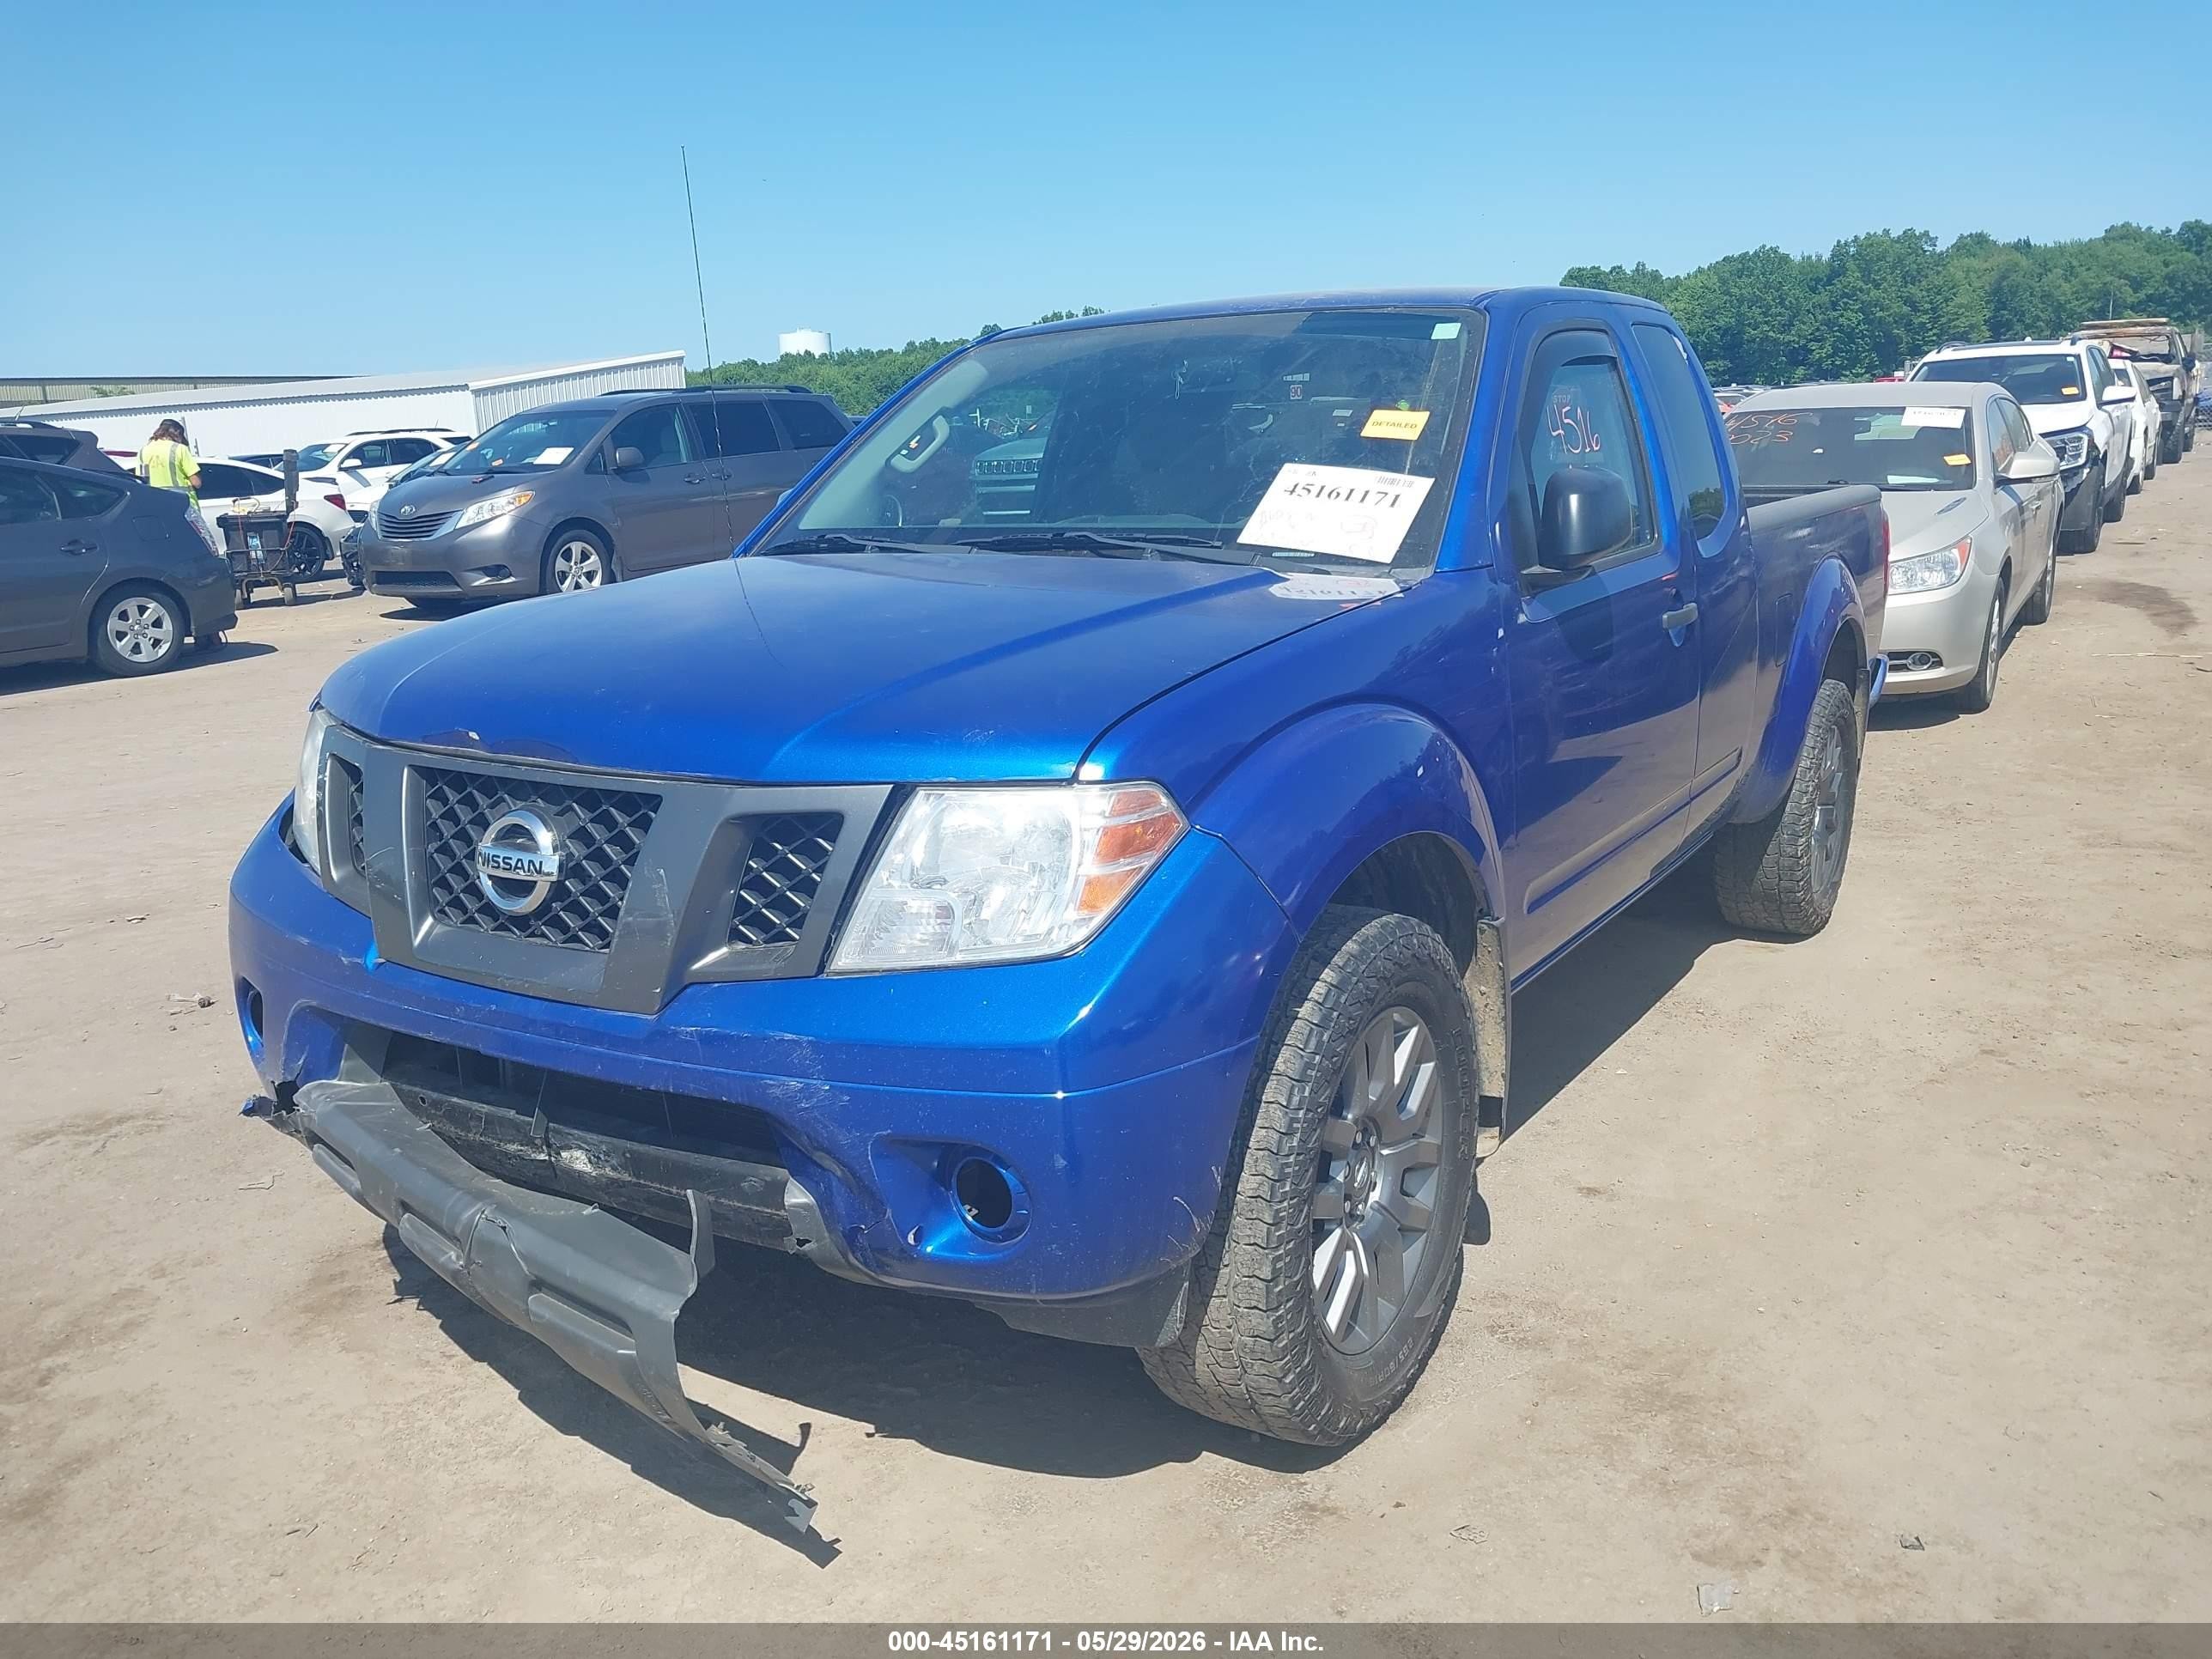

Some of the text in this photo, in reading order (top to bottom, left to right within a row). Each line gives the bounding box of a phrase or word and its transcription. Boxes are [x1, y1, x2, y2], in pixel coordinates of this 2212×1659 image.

[1371, 421, 1418, 429] DETAILED
[1547, 404, 1601, 454] 4516
[1284, 481, 1402, 509] 45161171
[477, 851, 544, 875] NISSAN
